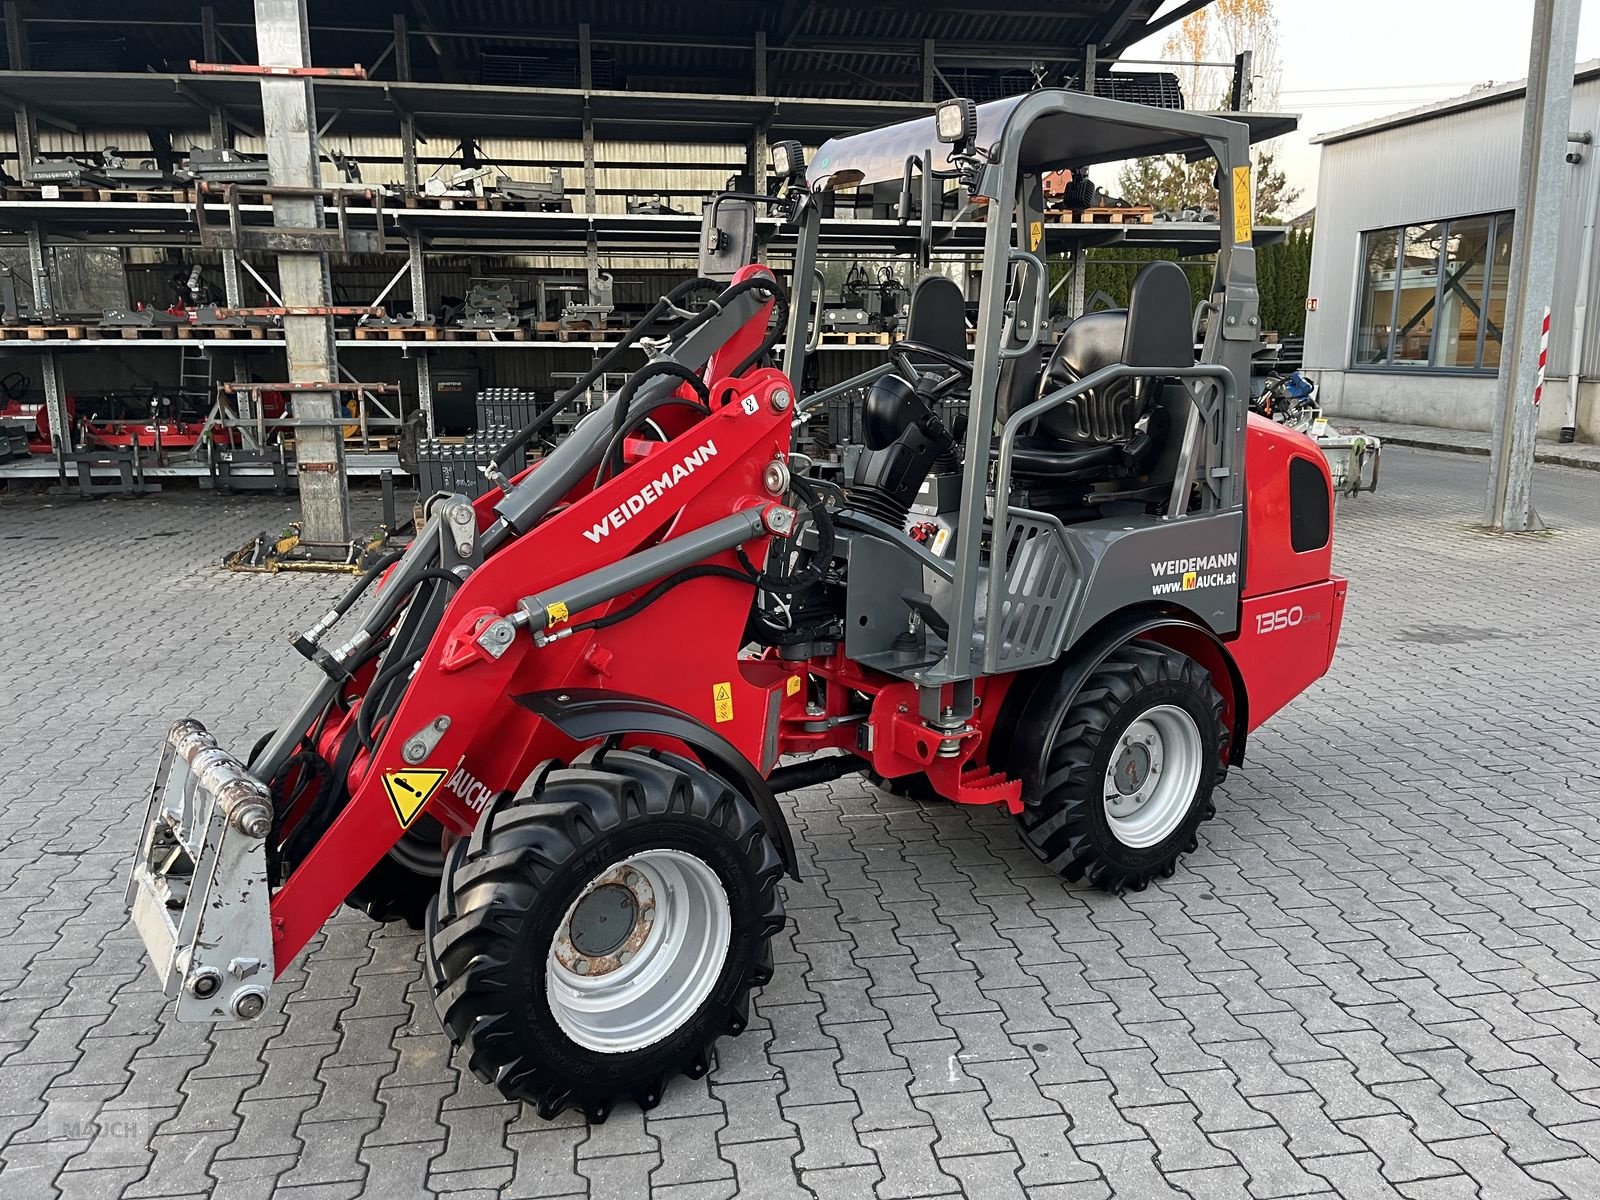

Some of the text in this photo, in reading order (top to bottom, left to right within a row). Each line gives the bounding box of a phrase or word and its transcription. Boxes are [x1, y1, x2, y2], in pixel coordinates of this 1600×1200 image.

[583, 439, 718, 543] WEIDEMANN
[1151, 552, 1238, 577] WEIDEMANN
[1152, 571, 1237, 596] www.MAUCH.at
[1255, 605, 1303, 635] 1350
[444, 767, 493, 814] AUCH
